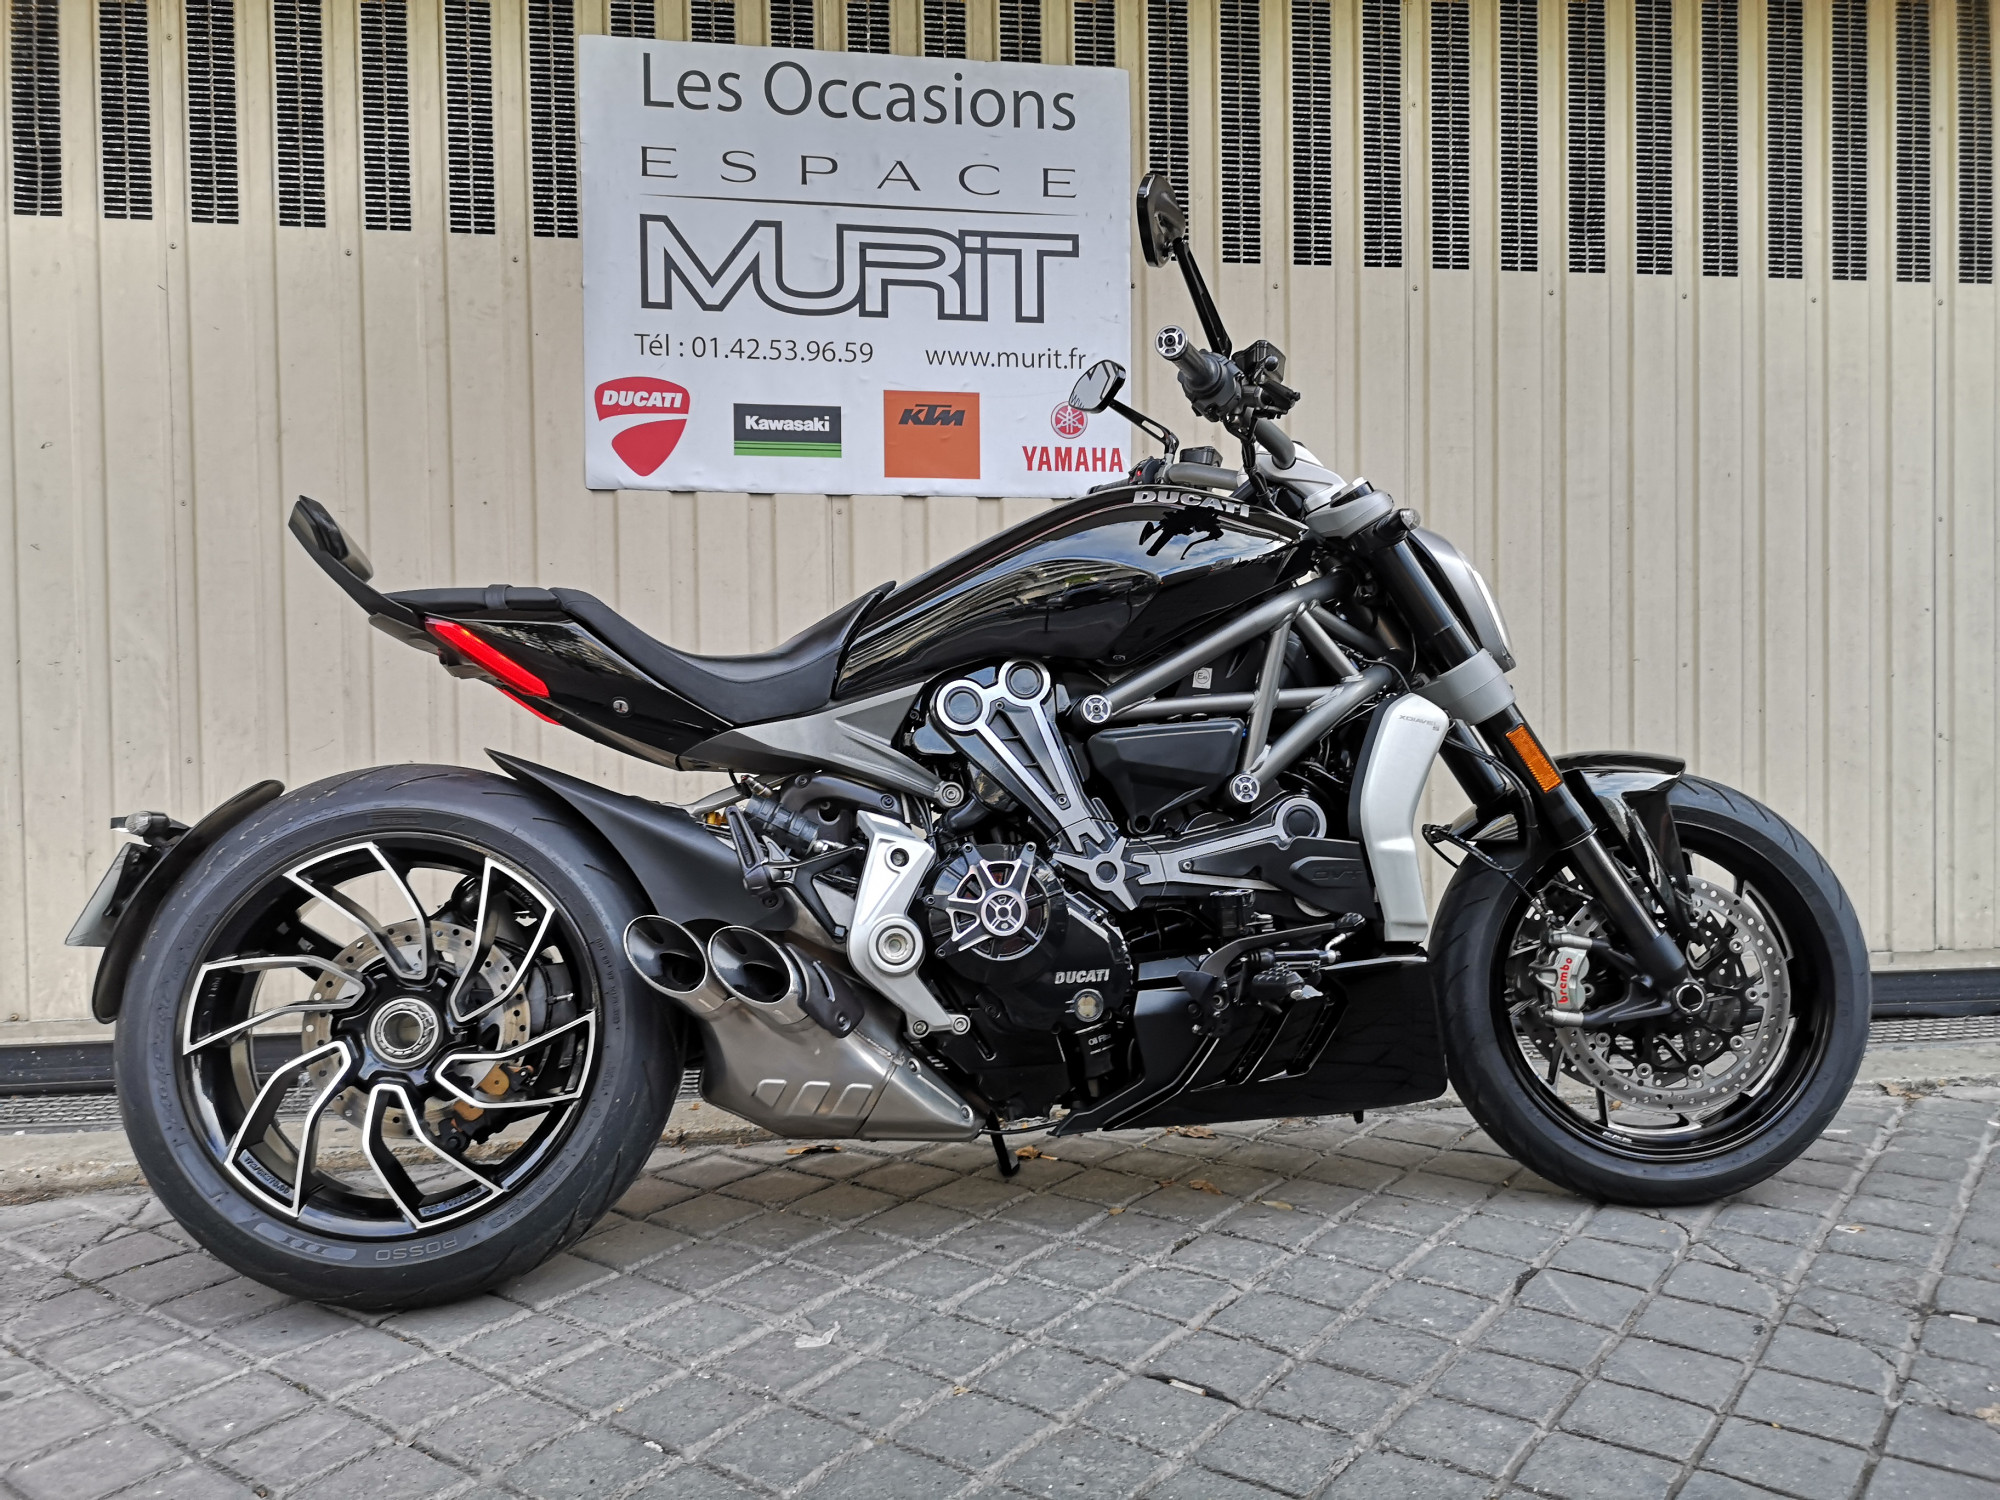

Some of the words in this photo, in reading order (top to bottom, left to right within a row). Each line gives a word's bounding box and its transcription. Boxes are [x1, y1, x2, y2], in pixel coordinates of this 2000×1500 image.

[642, 53, 743, 113] Les
[764, 60, 1077, 132] Occasions
[640, 146, 1078, 199] ESPACE
[634, 333, 670, 357] Tél
[692, 336, 875, 364] 01.42.53.96.59
[925, 347, 1087, 370] www.murit.fr
[601, 389, 683, 409] DUCATI
[744, 414, 830, 432] Kawasaki
[898, 403, 966, 427] KTM
[1021, 445, 1124, 473] YAMAHA
[1132, 490, 1250, 518] DUCATI
[1054, 968, 1111, 985] DUCATI
[1557, 957, 1573, 1004] brembo
[374, 1235, 459, 1262] ROSSO
